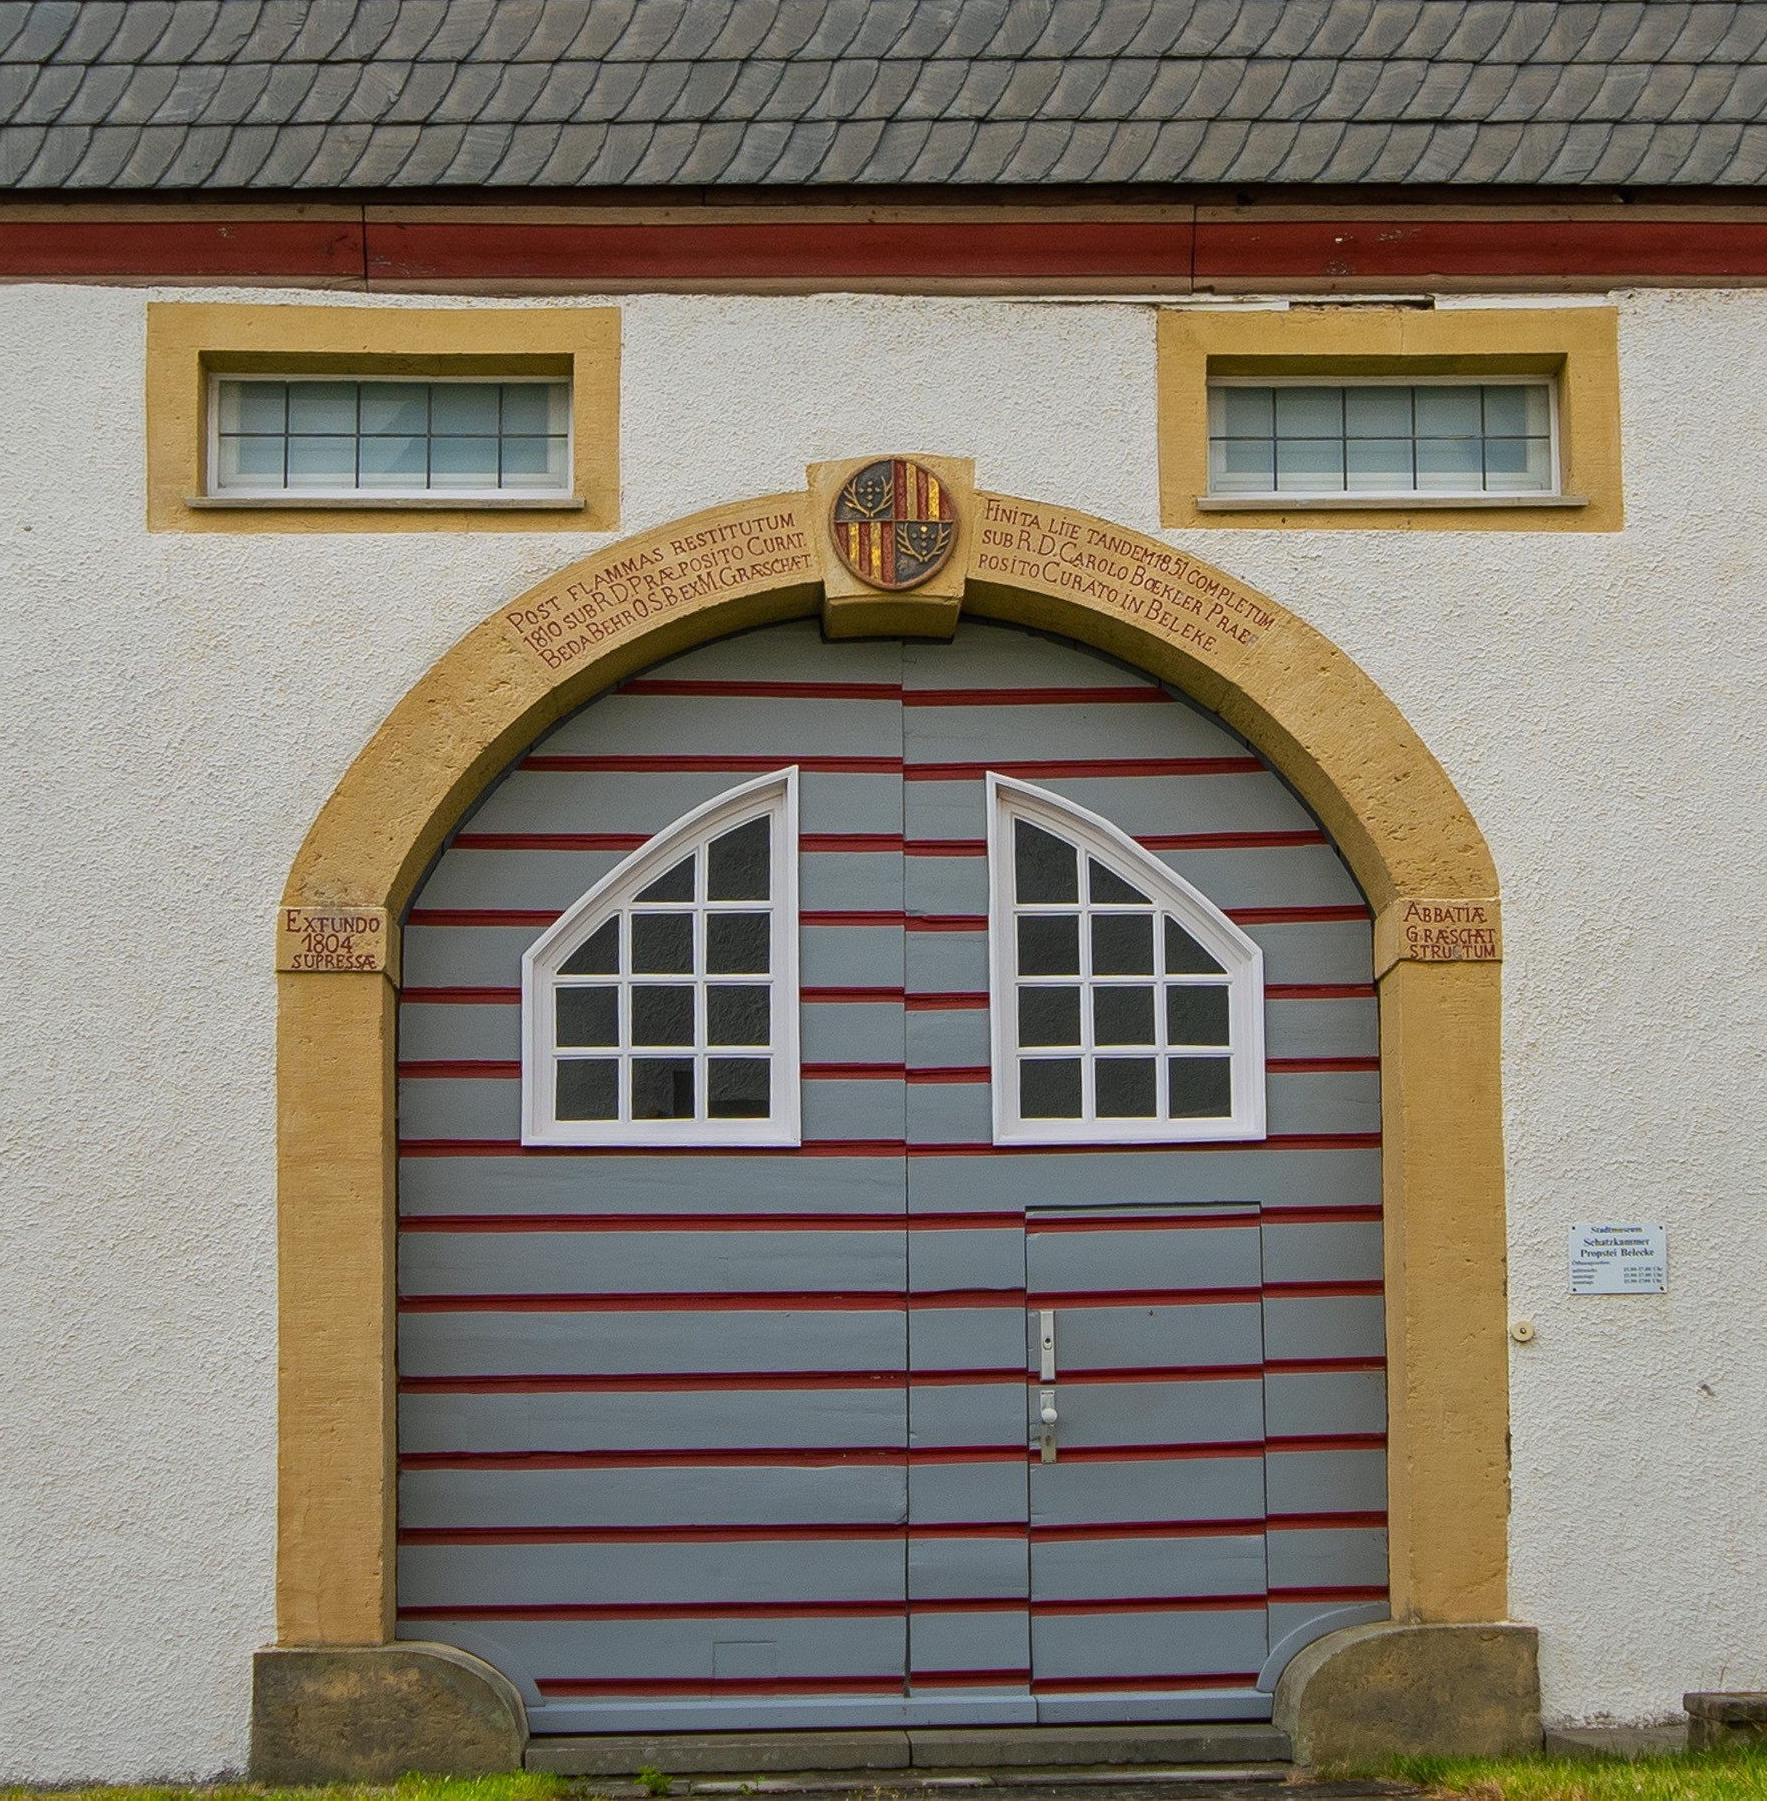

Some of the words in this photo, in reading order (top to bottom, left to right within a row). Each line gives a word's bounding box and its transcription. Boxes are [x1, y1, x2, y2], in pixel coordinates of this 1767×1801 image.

[982, 529, 1014, 548] SUB
[506, 596, 561, 634] POST
[567, 546, 664, 602] FLAMMAS
[670, 513, 795, 556] RESTITUTUM
[984, 499, 1042, 530] FINITA
[1087, 528, 1156, 566] TANDEM
[1153, 554, 1190, 580] 1851
[1186, 569, 1276, 631] COMPLETUM
[1042, 561, 1119, 603] CURATO
[1120, 589, 1145, 614] IN
[523, 620, 563, 652] 1810
[301, 933, 354, 954] 1804
[1580, 1248, 1617, 1259] Propstei
[1621, 1247, 1655, 1257] Belecke
[1583, 1238, 1650, 1247] Schatzkammer
